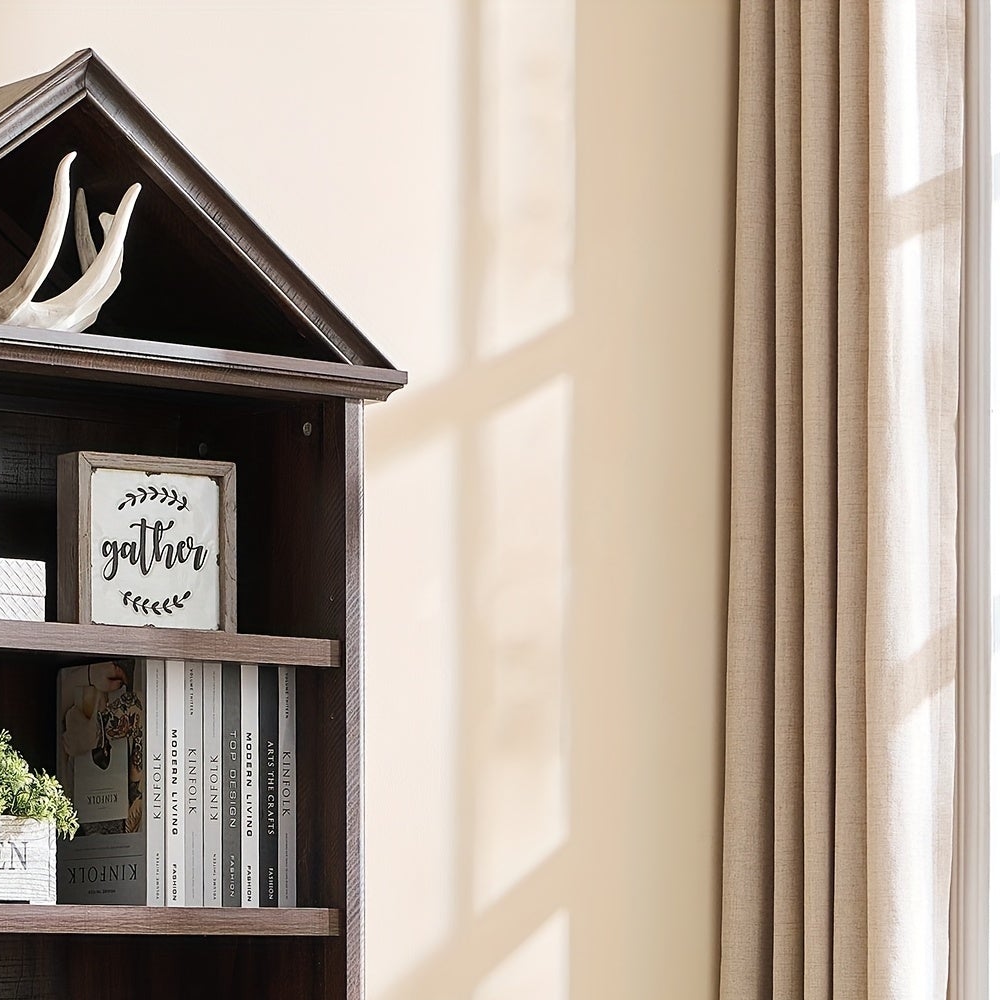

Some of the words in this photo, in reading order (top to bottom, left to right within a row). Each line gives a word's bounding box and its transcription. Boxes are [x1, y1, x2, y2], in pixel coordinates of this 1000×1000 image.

[101, 517, 209, 582] gather
[229, 730, 237, 761] TOP
[245, 732, 253, 787] MODERN
[267, 740, 275, 767] ARTS
[152, 753, 162, 820] KINFOLK
[188, 748, 197, 815] KINFOLK
[209, 754, 219, 821] KINFOLK
[229, 769, 237, 828] DESIGN
[267, 770, 275, 791] THE
[281, 751, 291, 817] KINFOLK
[267, 794, 275, 835] CRAFTS
[66, 863, 138, 884] KINFOLK
